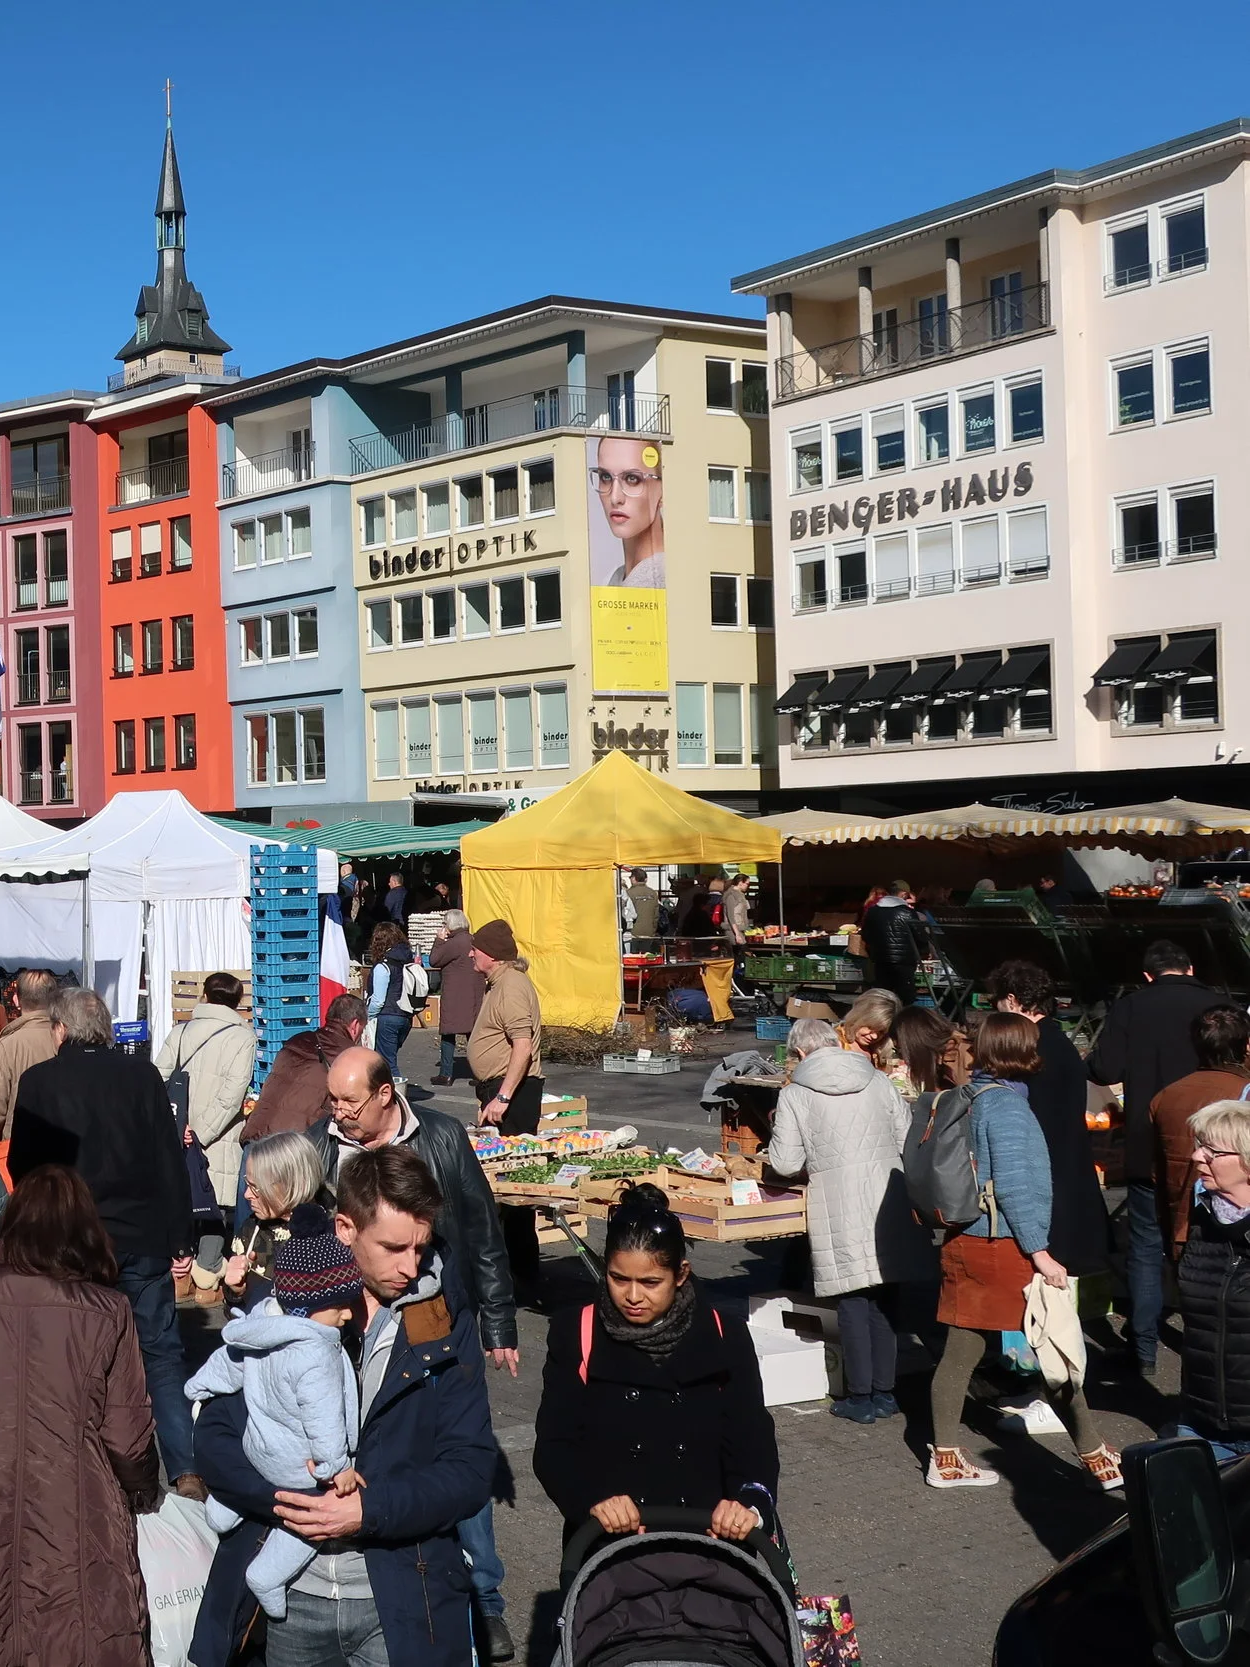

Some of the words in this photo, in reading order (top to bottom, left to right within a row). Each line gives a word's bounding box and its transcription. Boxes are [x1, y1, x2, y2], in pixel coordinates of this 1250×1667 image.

[790, 462, 1034, 540] BENGER-HAUS
[369, 546, 445, 581] binder
[457, 529, 538, 565] OPTIK
[597, 600, 627, 609] GROSSE
[628, 601, 659, 611] MARKEN
[474, 736, 497, 745] binder
[543, 732, 568, 741] binder
[591, 720, 669, 750] binder
[677, 730, 703, 739] binder
[409, 742, 431, 751] binder
[415, 779, 462, 794] binder
[1042, 790, 1095, 814] Sabo
[154, 1587, 203, 1610] GALERIA
